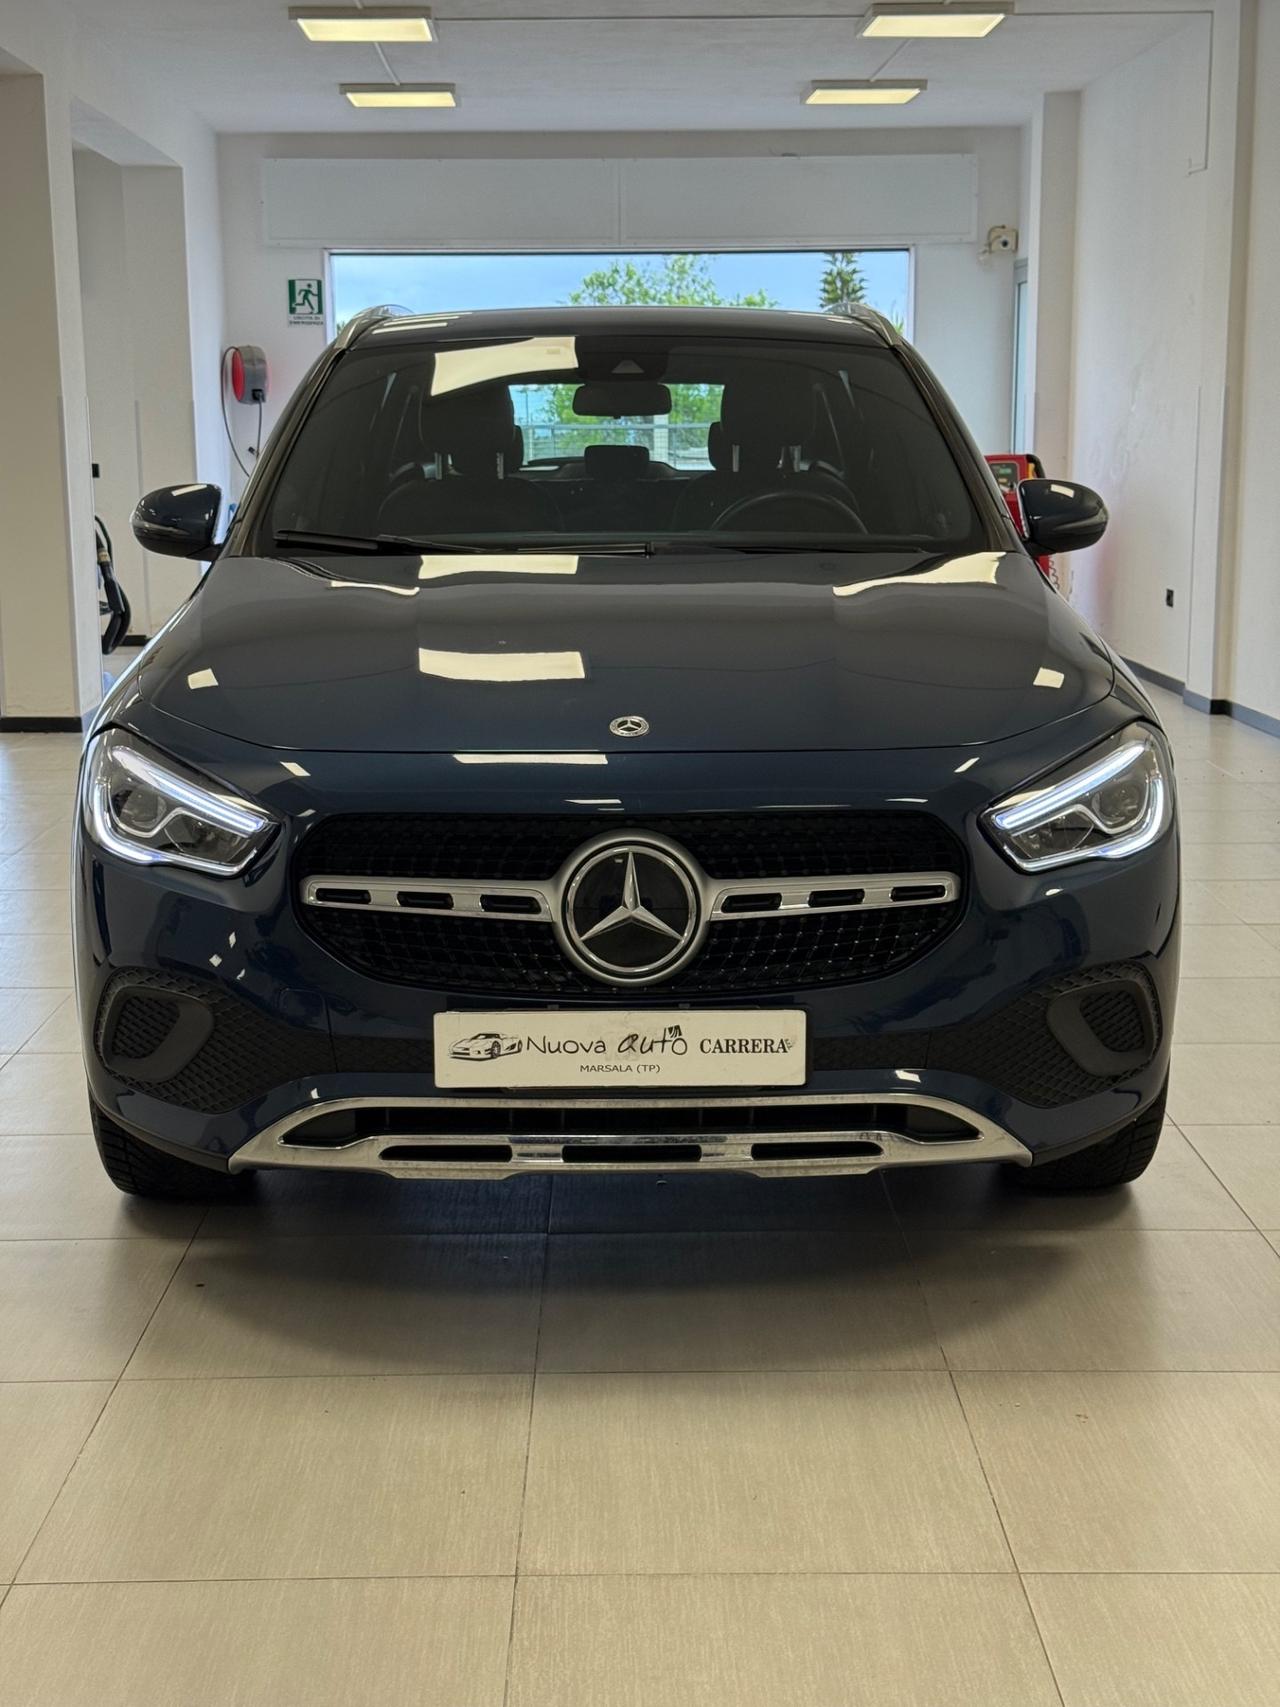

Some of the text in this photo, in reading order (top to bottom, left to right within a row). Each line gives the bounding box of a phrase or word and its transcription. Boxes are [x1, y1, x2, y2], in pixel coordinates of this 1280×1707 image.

[527, 1035, 606, 1056] Nuova
[700, 1038, 788, 1054] CARRERA
[580, 1064, 661, 1074] MARSALA (TP)
